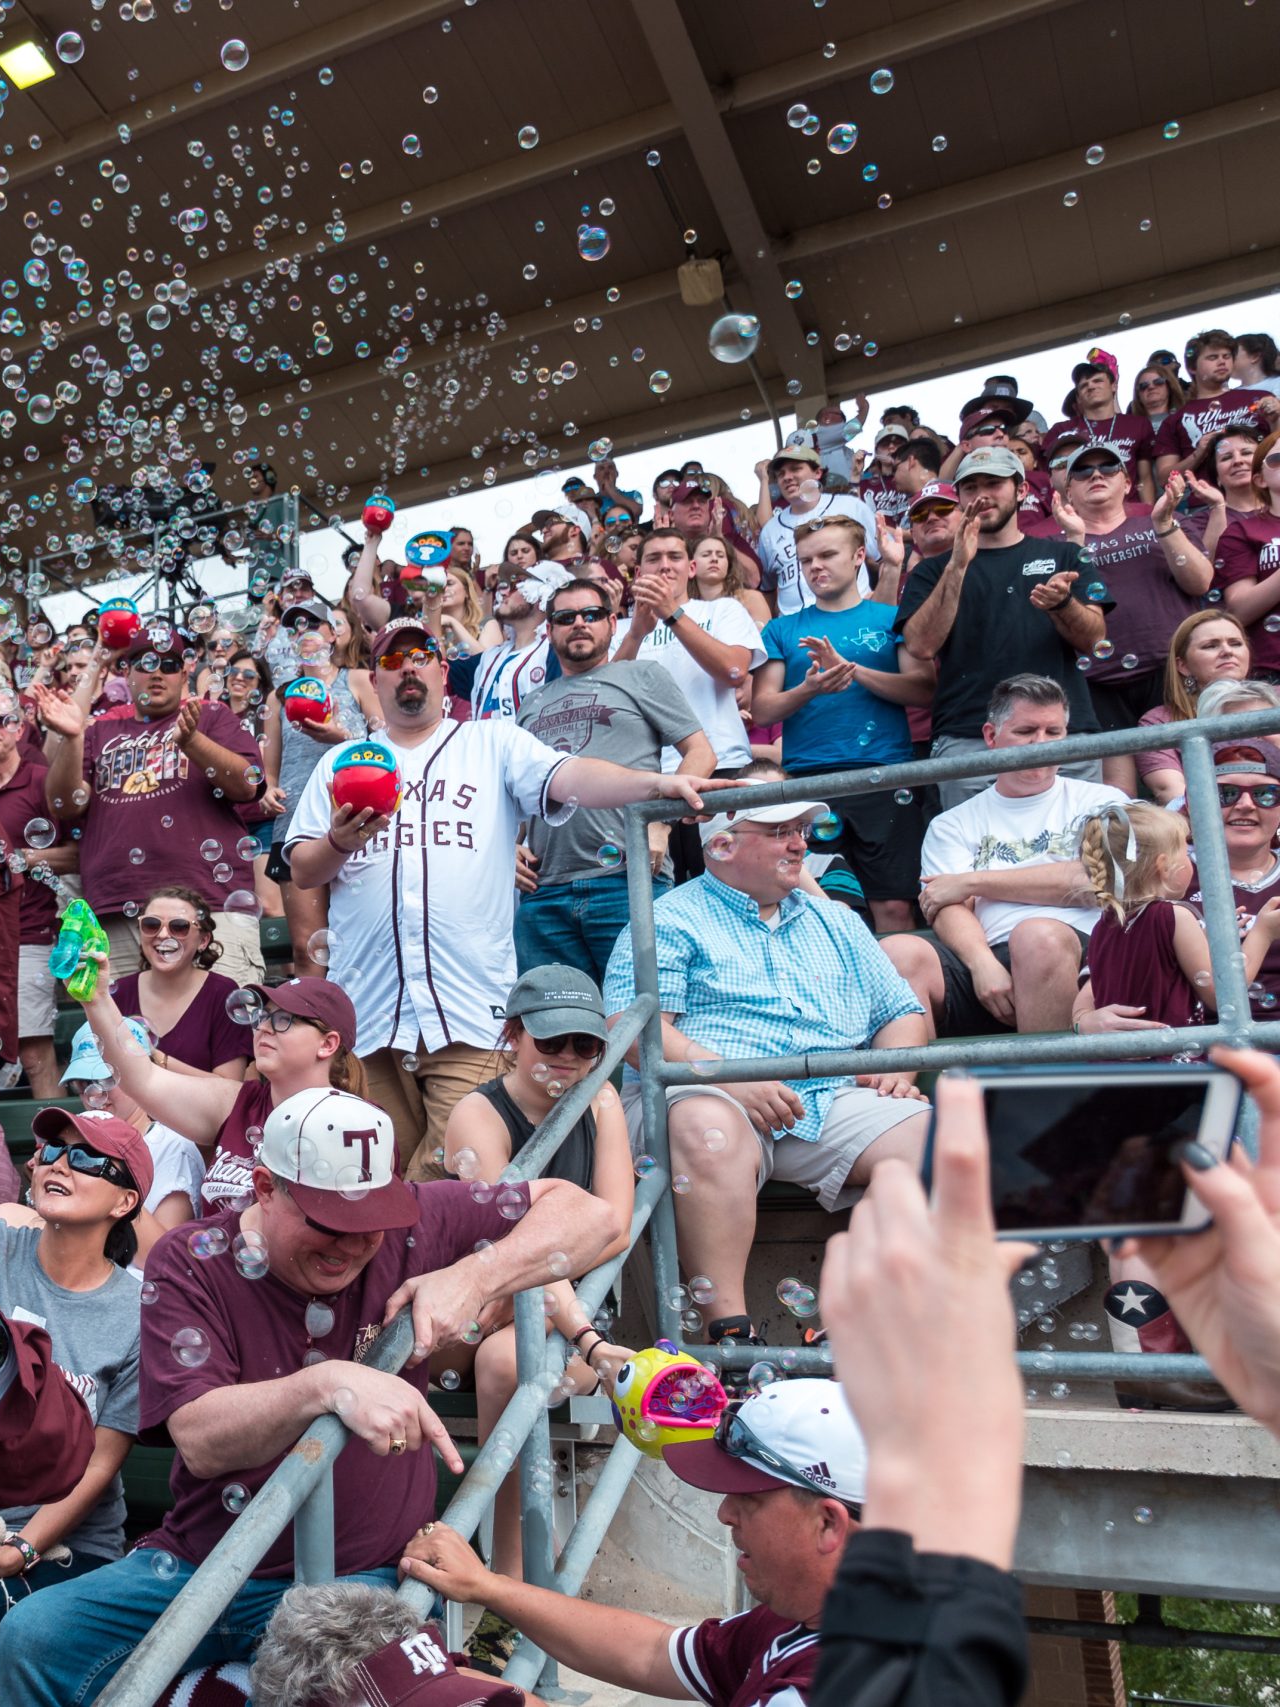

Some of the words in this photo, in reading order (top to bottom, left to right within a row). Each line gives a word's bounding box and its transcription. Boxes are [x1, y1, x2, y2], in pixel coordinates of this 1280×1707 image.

[1090, 543, 1150, 568] NIVERSITY
[102, 730, 160, 755] Catch
[403, 779, 477, 810] XAS
[343, 1128, 379, 1183] T
[799, 1469, 837, 1489] adidas
